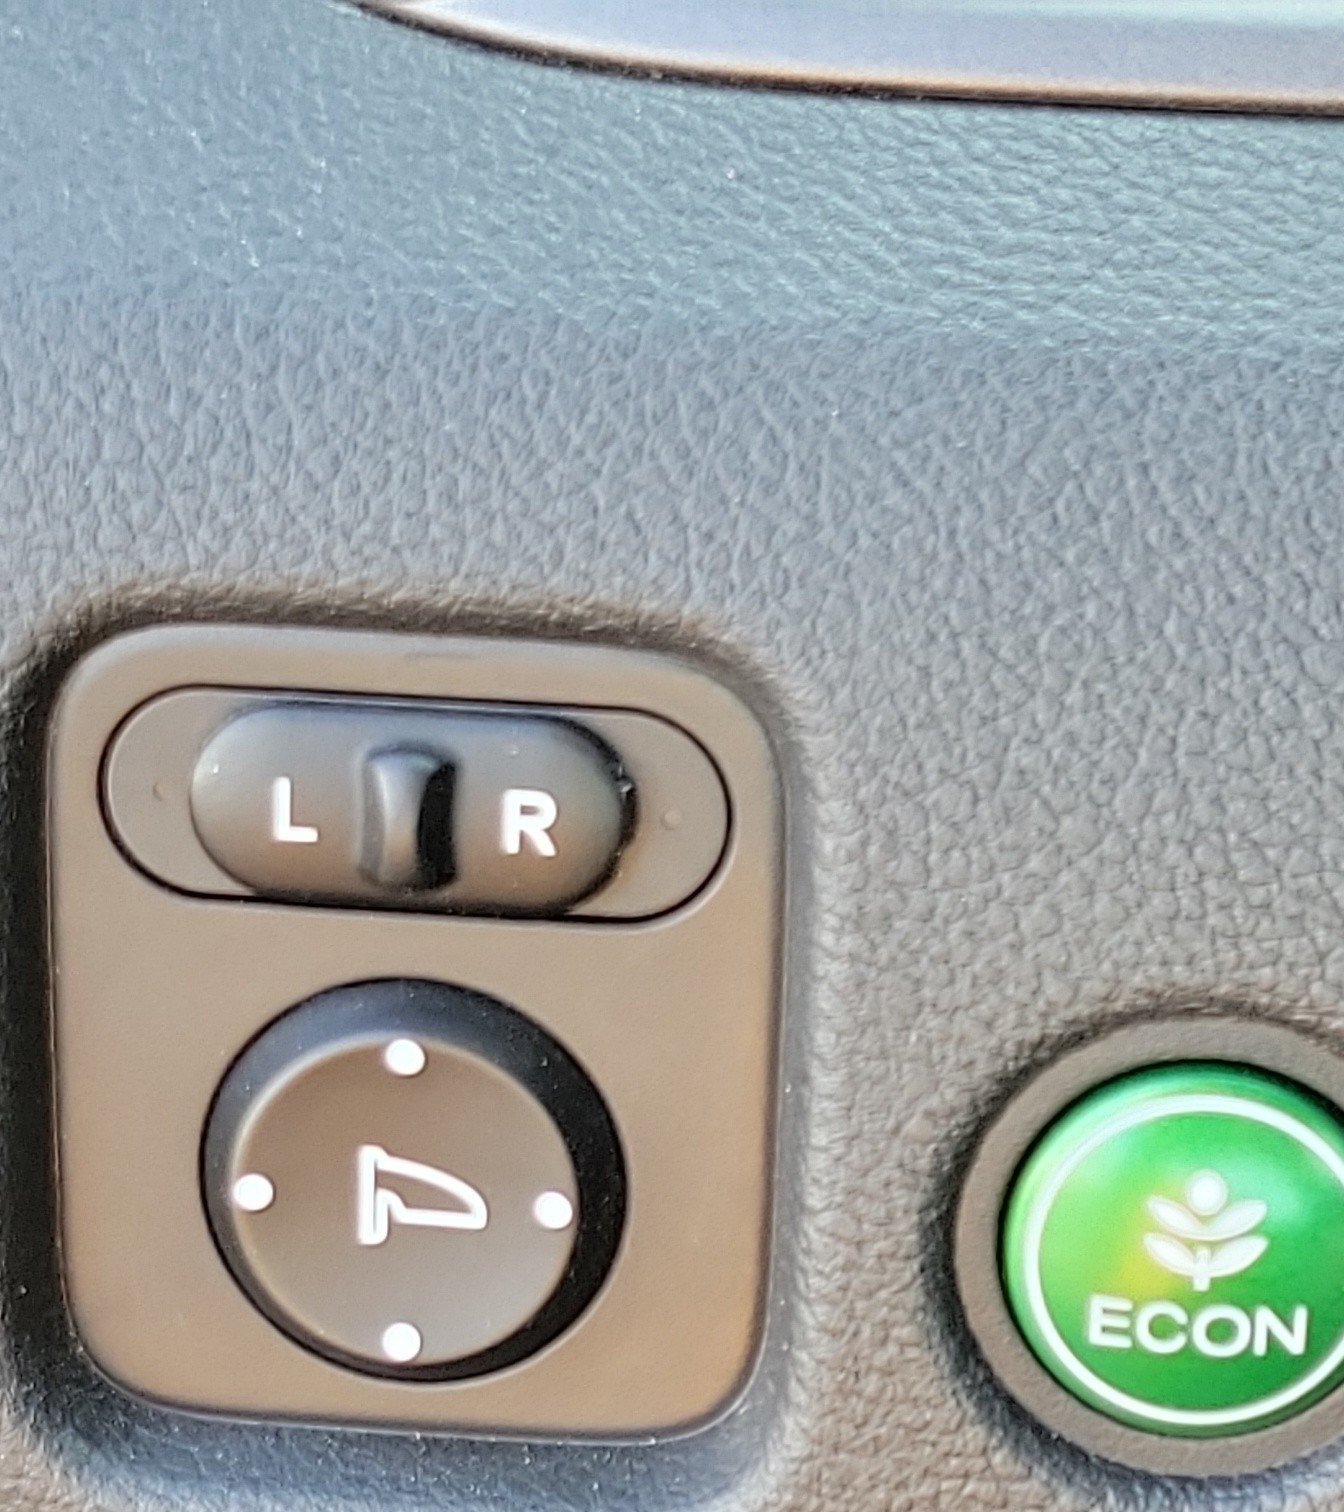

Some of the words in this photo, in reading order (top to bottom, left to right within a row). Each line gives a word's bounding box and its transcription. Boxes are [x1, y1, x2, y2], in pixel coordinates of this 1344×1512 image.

[272, 776, 319, 844] L
[501, 788, 558, 858] R
[1088, 1294, 1308, 1358] ECON
